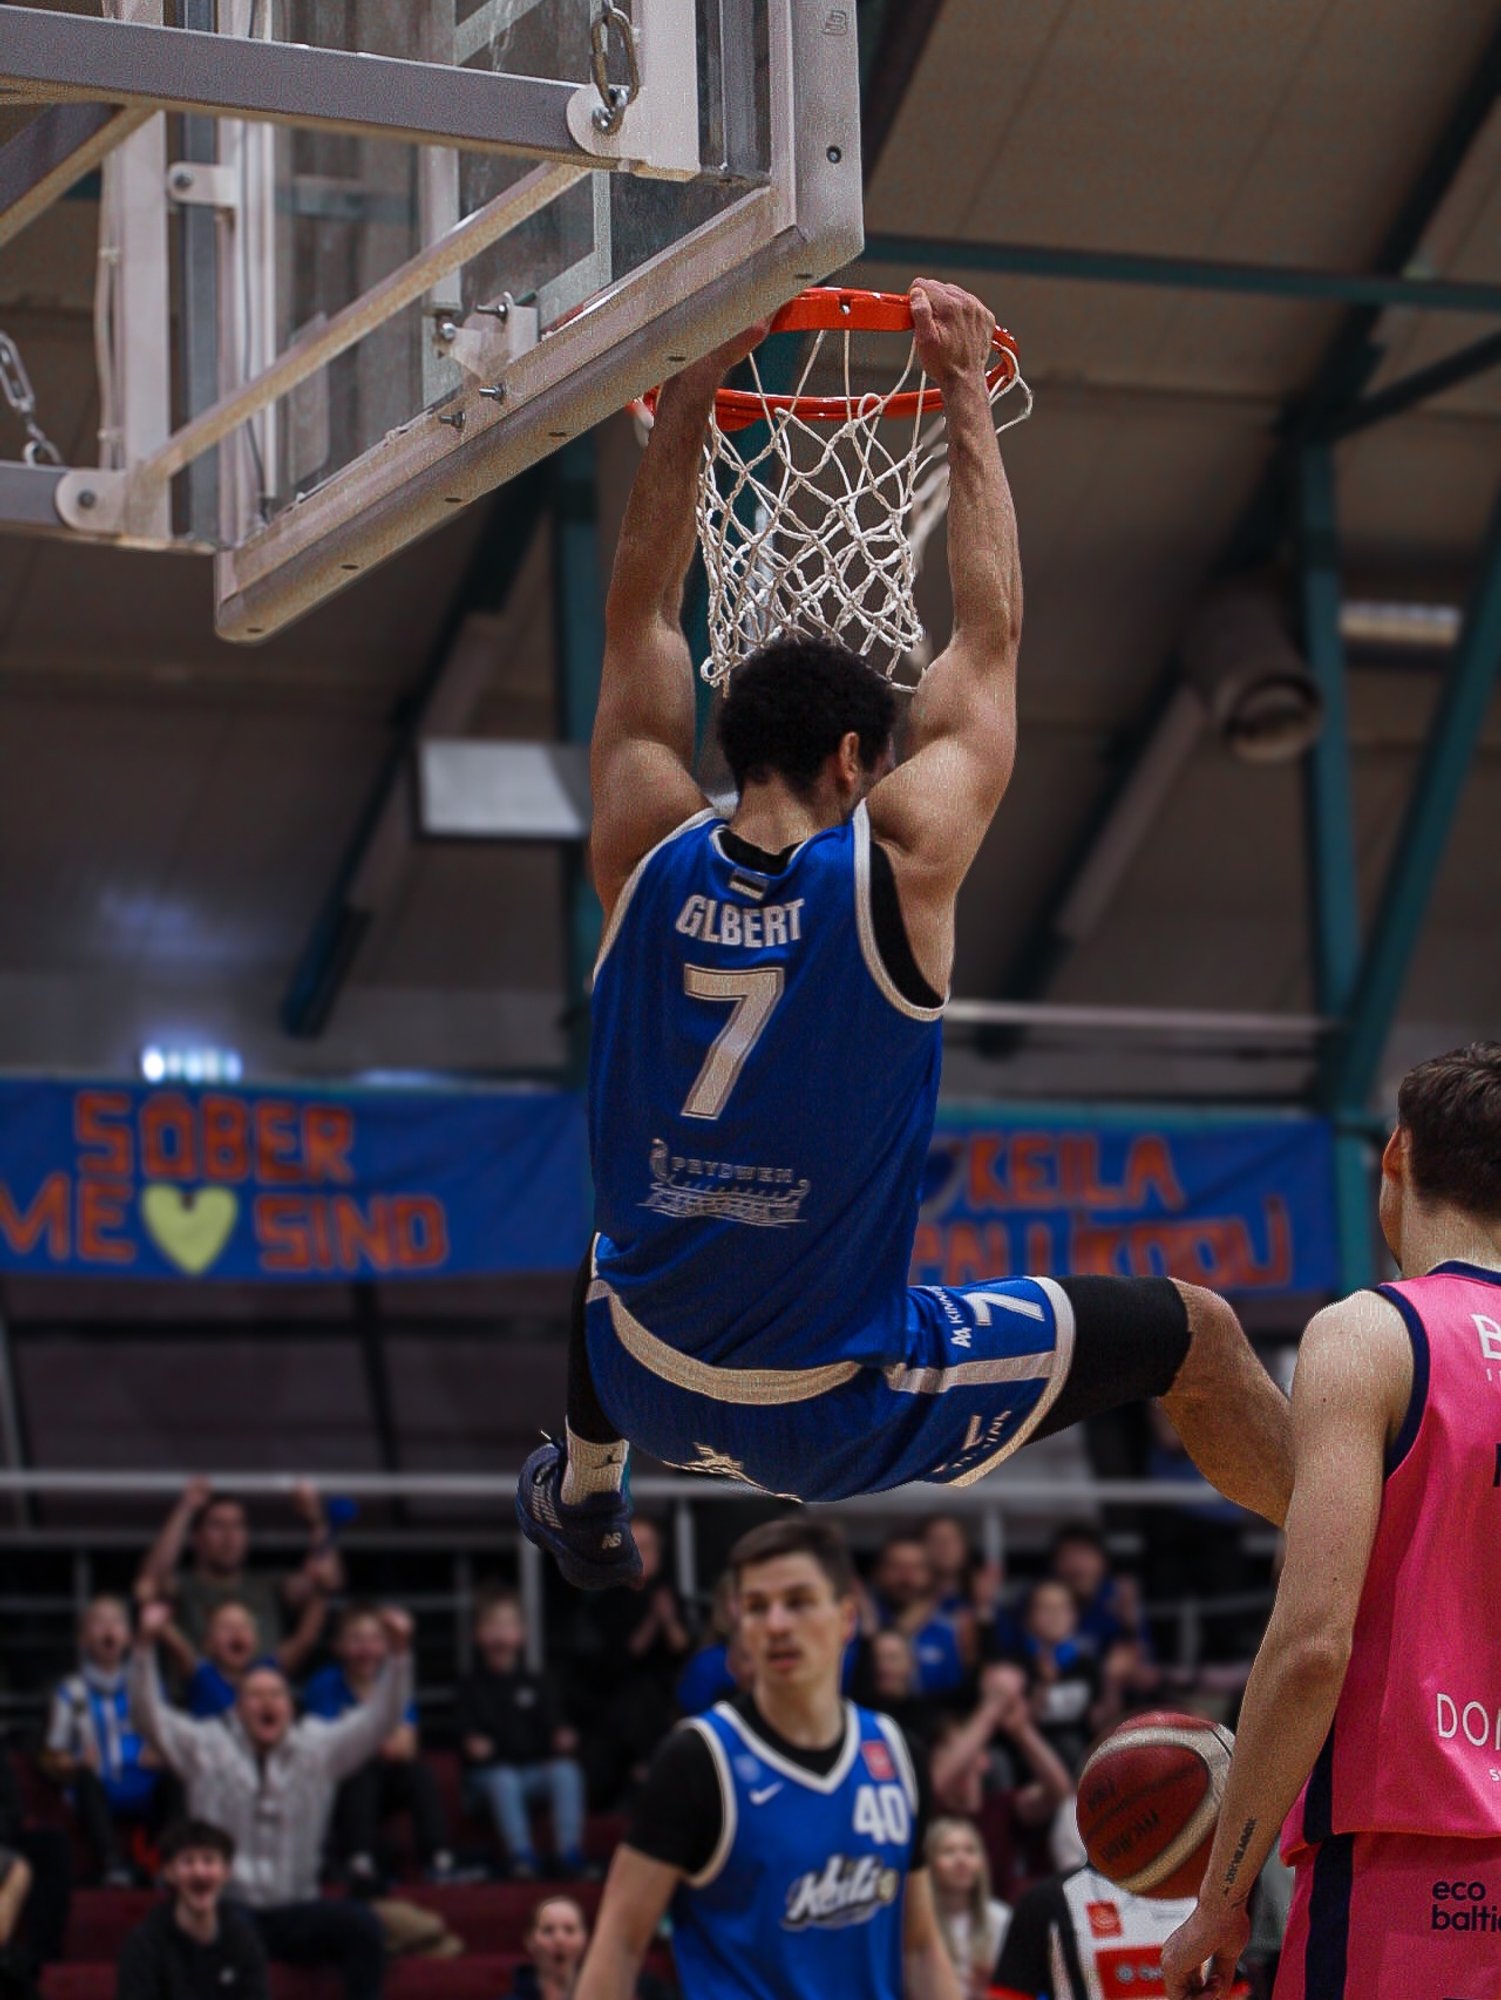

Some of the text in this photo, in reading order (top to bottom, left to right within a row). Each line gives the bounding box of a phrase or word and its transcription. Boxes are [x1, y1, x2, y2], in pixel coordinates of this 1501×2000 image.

[680, 963, 785, 1120] 7
[968, 1132, 1186, 1211] KEILA
[0, 1171, 136, 1262] ME
[961, 1291, 1046, 1326] 7
[1436, 1692, 1501, 1751] DO
[853, 1783, 910, 1846] 40
[1431, 1881, 1487, 1902] eco
[1431, 1903, 1501, 1932] balti
